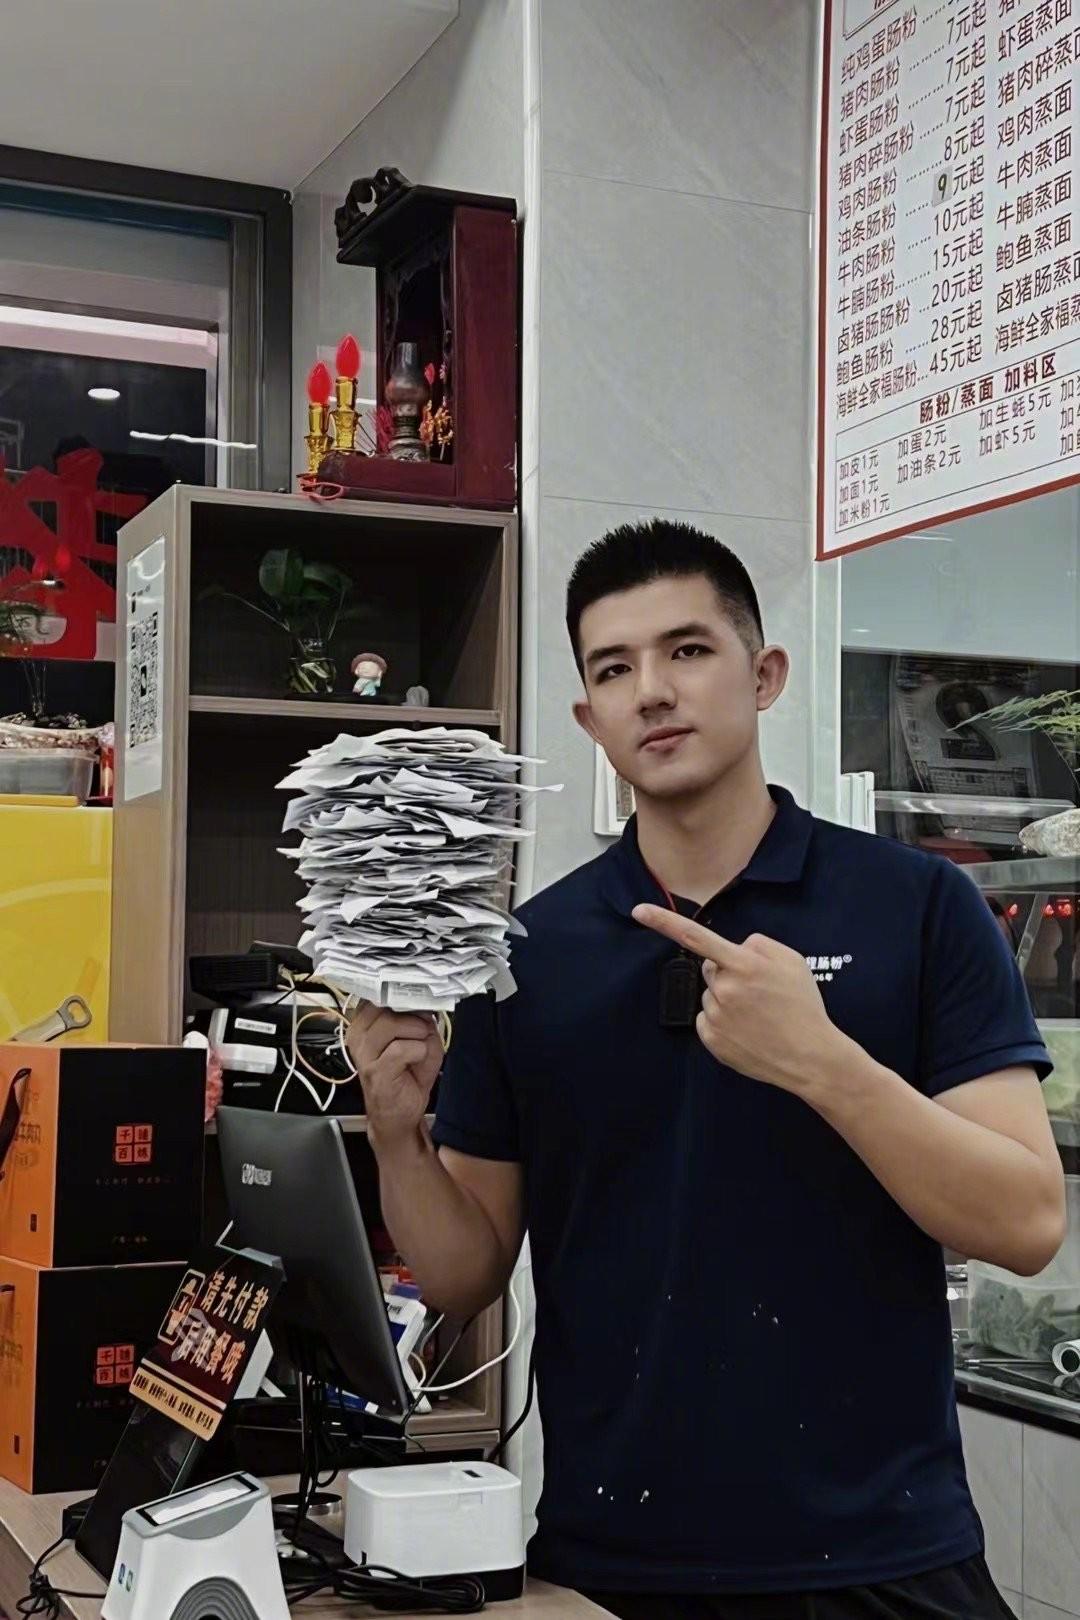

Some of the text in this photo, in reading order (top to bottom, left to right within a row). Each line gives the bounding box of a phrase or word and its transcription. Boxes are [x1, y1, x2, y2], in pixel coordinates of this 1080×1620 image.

[841, 5, 917, 85] 纯鸡蛋肠粉
[947, 0, 986, 44] 7元起
[997, 0, 1072, 61] 虾蛋蒸面
[840, 35, 986, 122] 猪肉肠粉 7元起
[839, 75, 985, 157] 虾蛋肠粉 7元起
[997, 79, 1072, 149] 鸡肉蒸面
[839, 115, 985, 190] 猪肉碎肠粉 8元起
[997, 126, 1072, 190] 牛肉蒸面
[838, 167, 898, 221] 鸡肉肠粉
[838, 191, 984, 256] 油条肠粉 10元起
[996, 170, 1072, 231] 牛腩蒸面
[837, 227, 984, 288] 牛肉肠粉 15元起
[996, 213, 1072, 272] 鲍鱼蒸面
[837, 263, 983, 321] 牛腩肠粉 20元起
[837, 296, 983, 355] 卤猪肠肠粉 28元起
[836, 334, 982, 387] 鲍鱼肠粉 45元起
[919, 352, 1056, 424] 肠粉/蒸面 加料区
[978, 387, 1052, 431] 加生蚝5元
[978, 420, 1036, 457] 加虾5元
[839, 449, 880, 481] 加皮1元
[897, 424, 947, 460] 加蛋2元
[897, 445, 962, 485] 加油条2元
[838, 493, 890, 527] 加米粉1元
[839, 474, 880, 504] 加面1元
[200, 1270, 269, 1331] 请先付款
